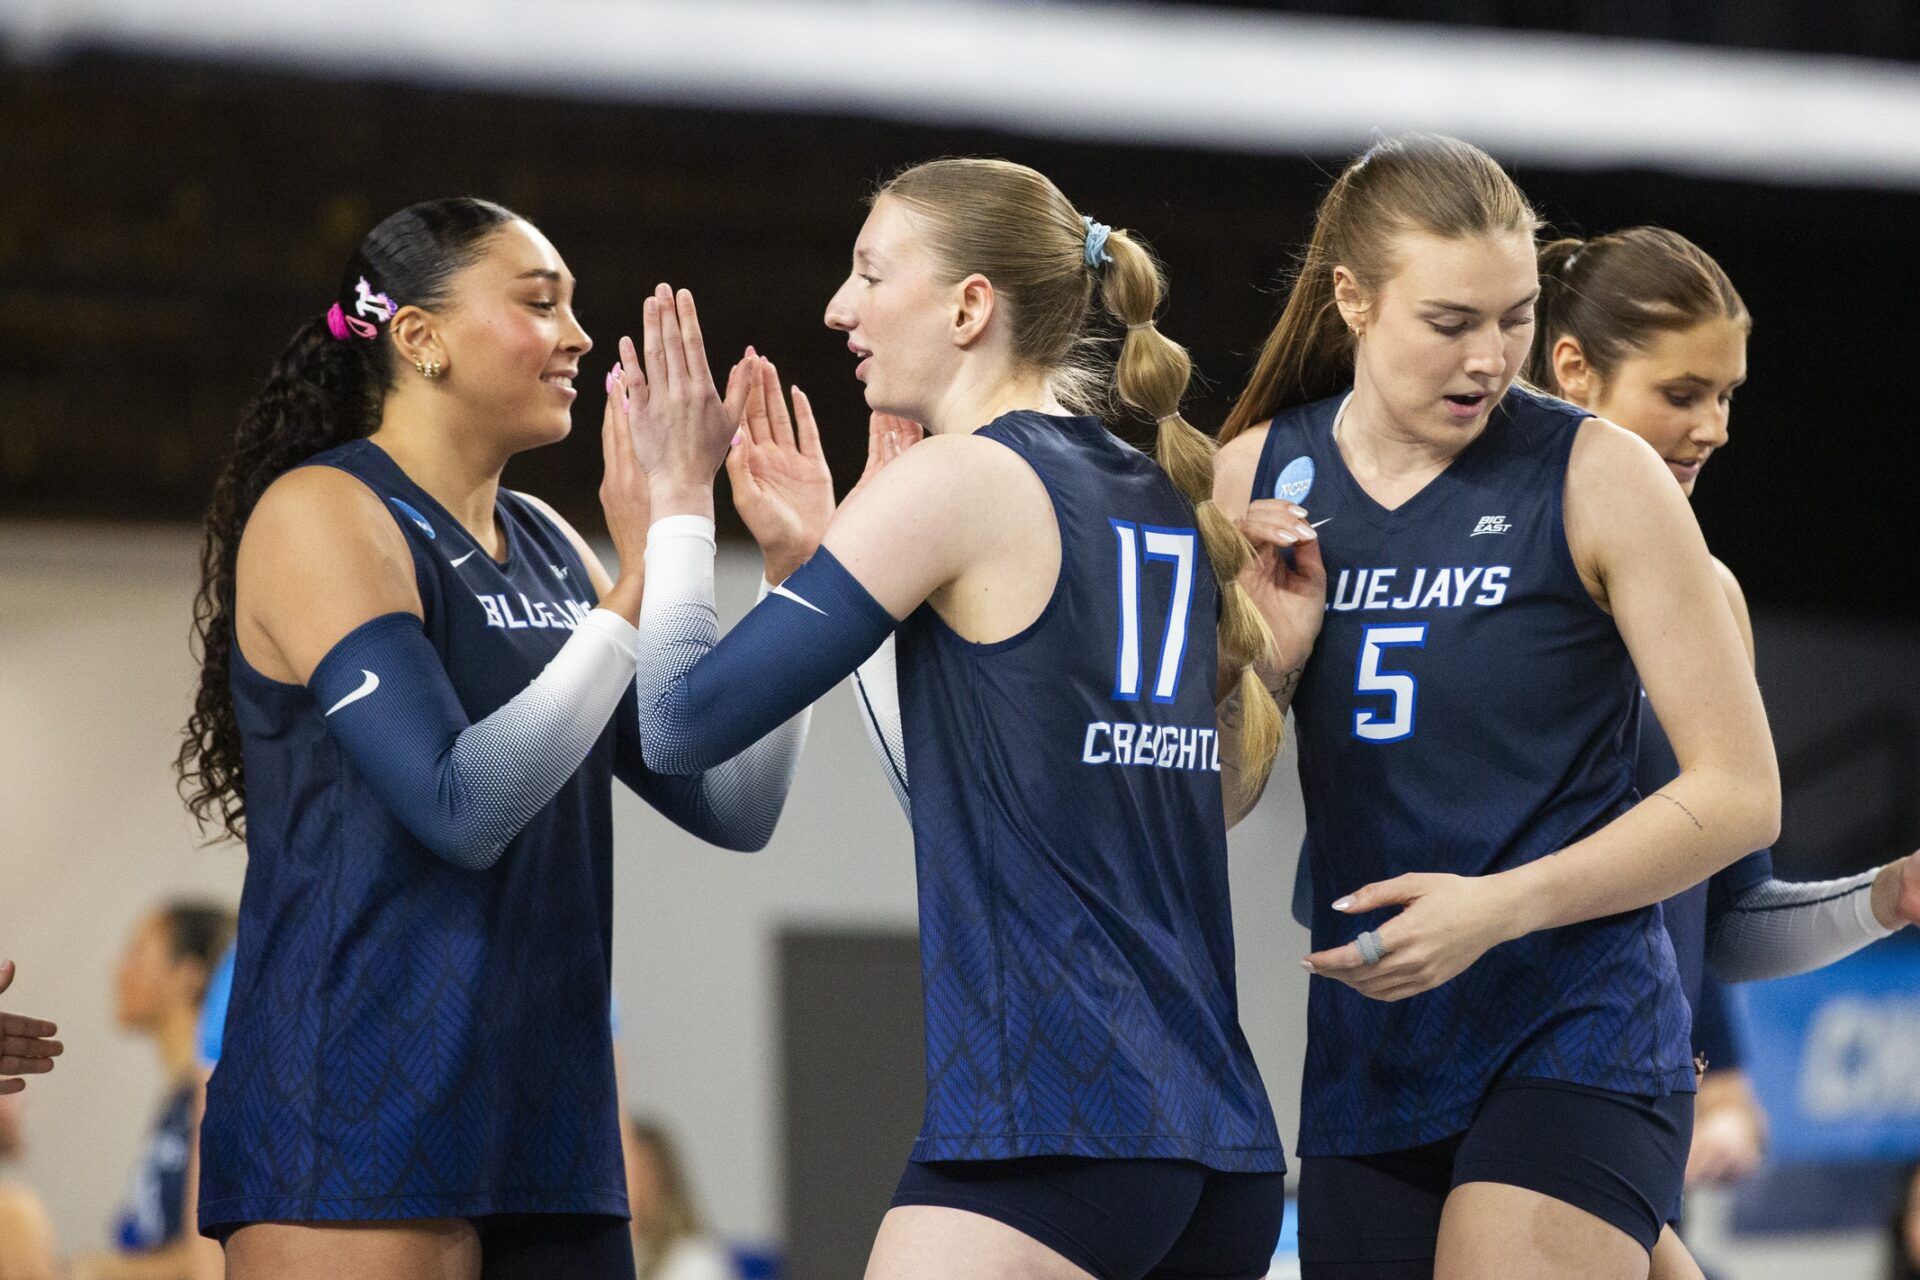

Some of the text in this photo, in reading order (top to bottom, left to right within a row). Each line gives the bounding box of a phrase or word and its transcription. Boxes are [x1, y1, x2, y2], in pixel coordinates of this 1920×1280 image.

[1473, 524, 1513, 533] EAST
[1478, 515, 1506, 525] BIG
[1108, 517, 1197, 704] 17
[1325, 565, 1512, 612] UEJAYS
[1352, 622, 1429, 744] 5
